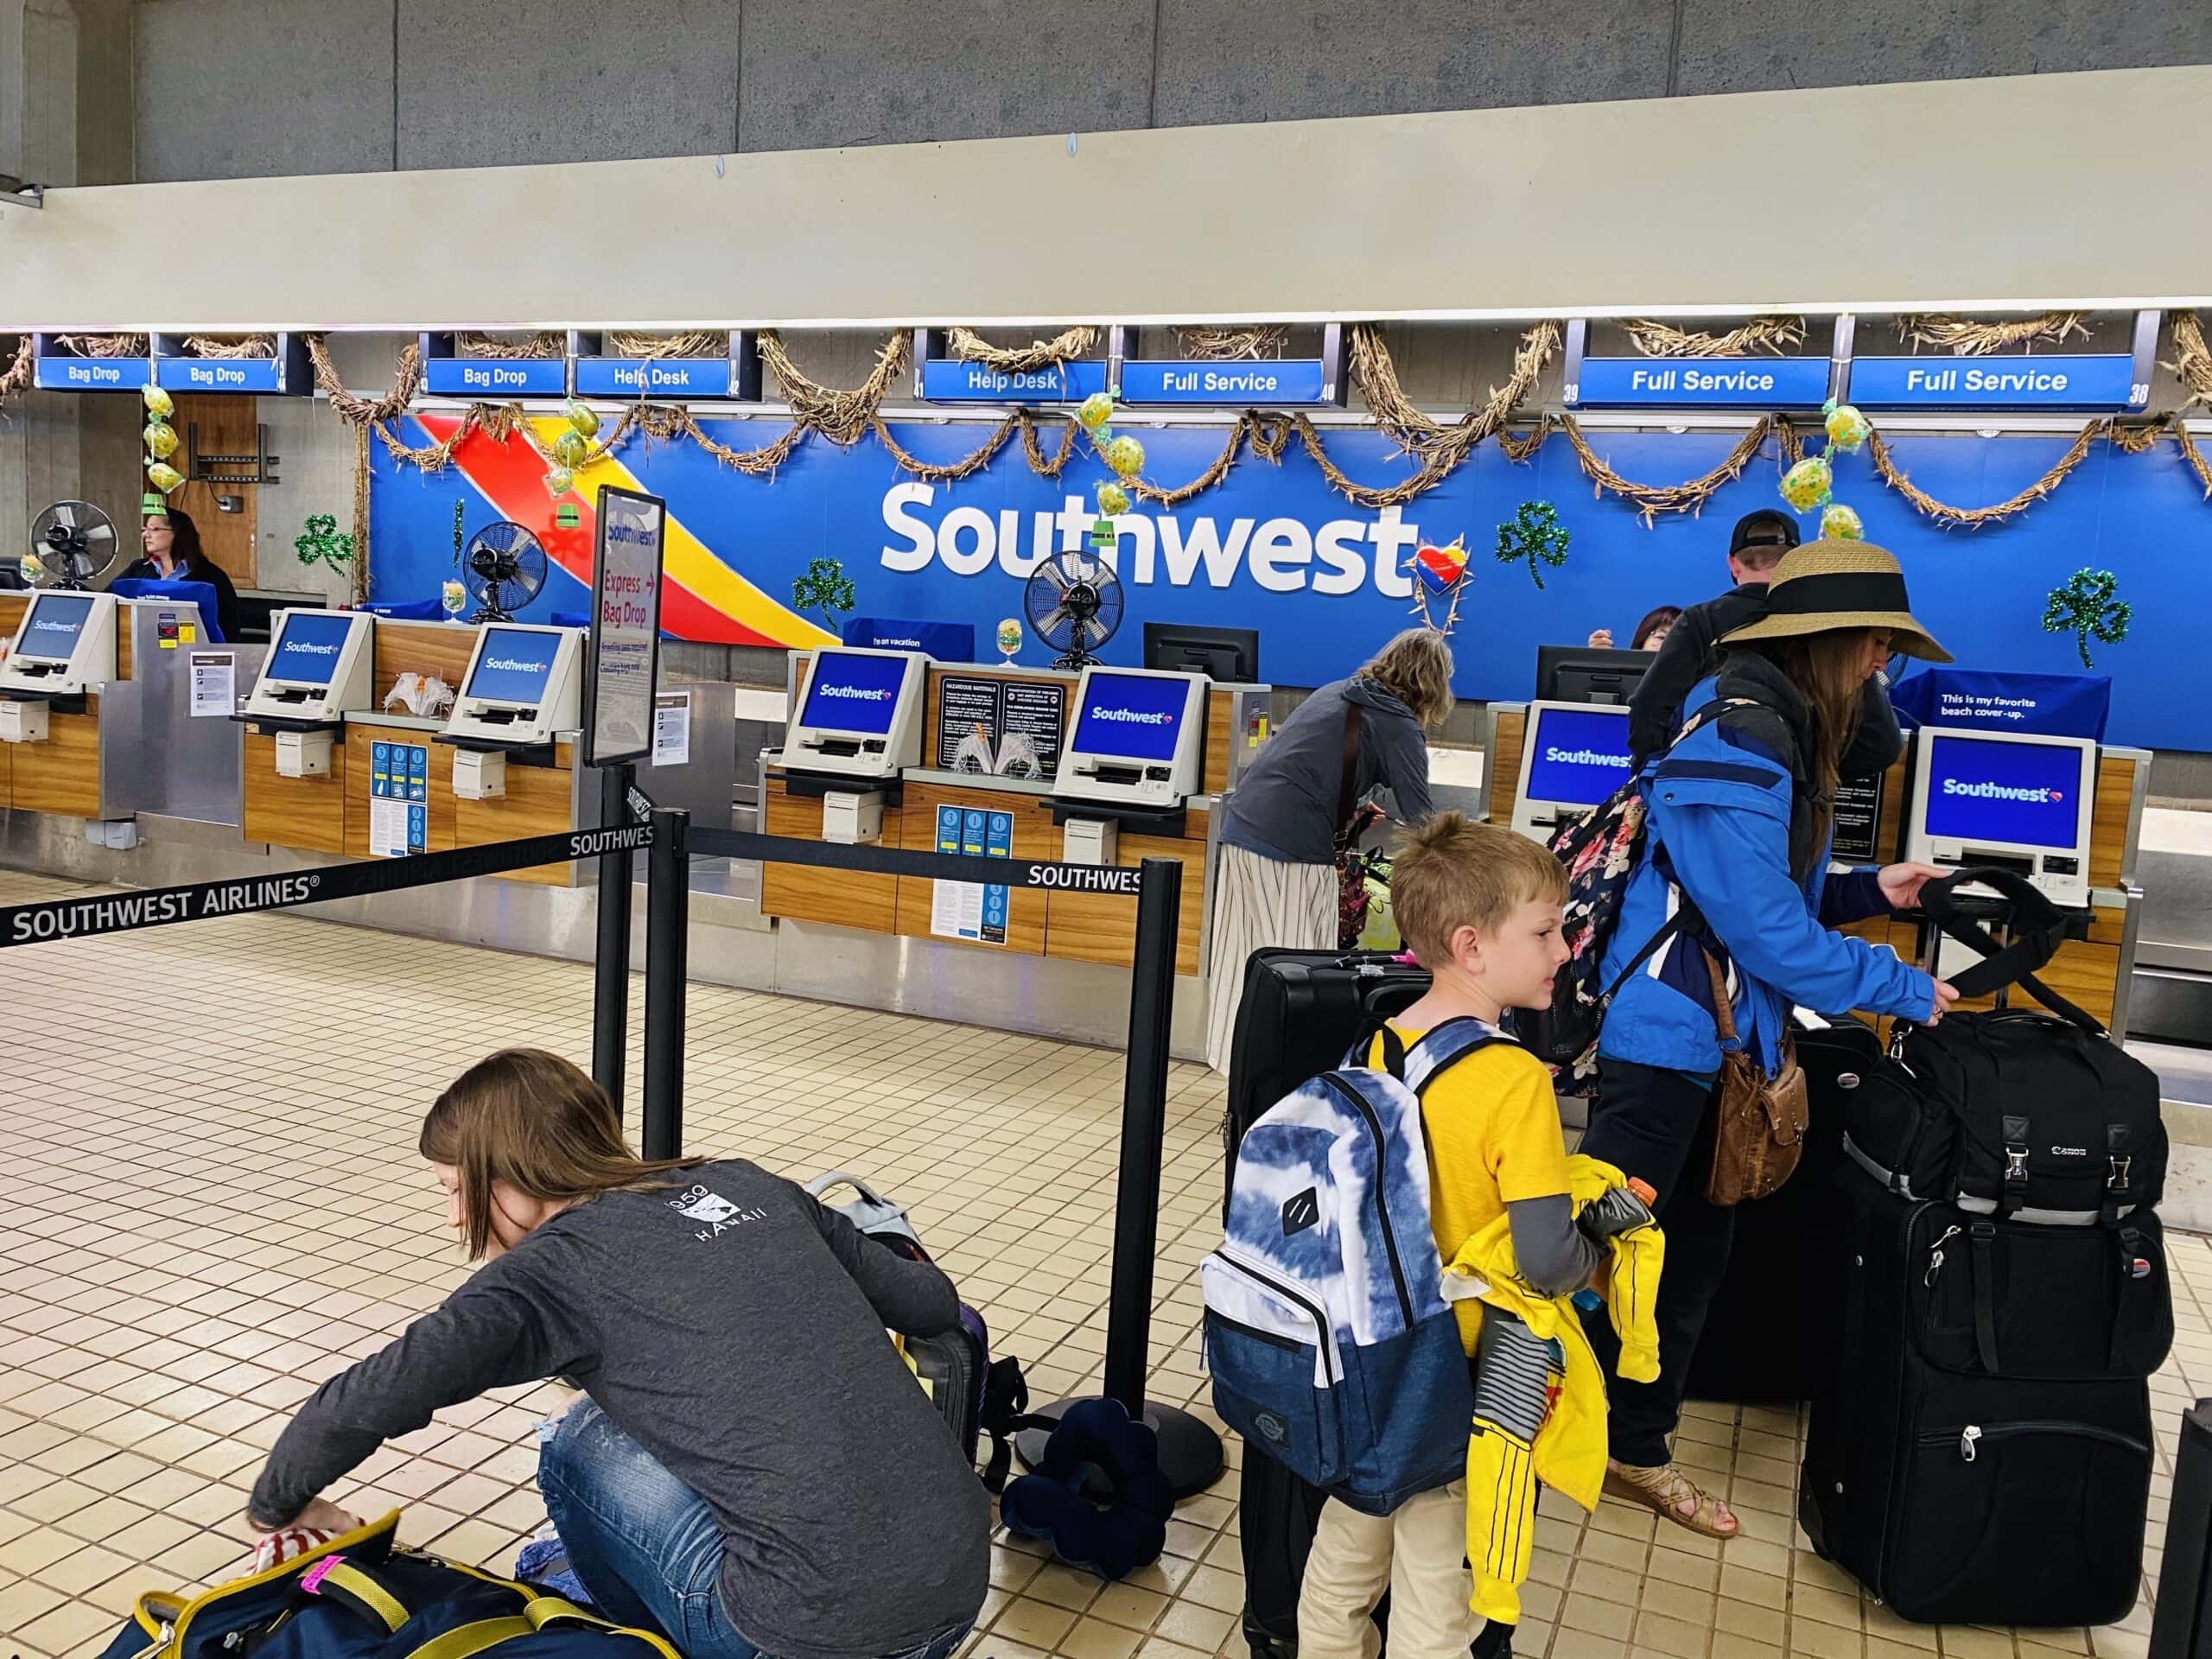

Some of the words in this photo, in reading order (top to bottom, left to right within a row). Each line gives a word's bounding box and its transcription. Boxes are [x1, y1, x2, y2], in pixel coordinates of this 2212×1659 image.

[68, 366, 91, 383] Bag
[92, 366, 120, 383] Drop
[189, 367, 213, 385] Bag
[216, 368, 245, 385] Drop
[463, 368, 490, 387] Bag
[493, 368, 527, 387] Drop
[613, 368, 647, 387] Help
[652, 369, 690, 385] Desk
[968, 372, 1007, 392] Help
[1013, 373, 1058, 390] Desk
[1163, 372, 1198, 391] Full
[1204, 372, 1278, 391] Service
[1631, 371, 1676, 391] Full
[1682, 370, 1775, 391] Service
[1906, 369, 1957, 391] Full
[1963, 369, 2069, 391] Service
[1322, 383, 1335, 402] 40
[1563, 384, 1579, 402] 39
[2129, 383, 2150, 404] 38
[607, 524, 652, 546] Southwest
[880, 482, 1420, 598] Southwest
[604, 569, 641, 598] Express
[603, 601, 621, 629] Bag
[624, 601, 646, 629] Drop
[34, 620, 76, 632] Southwest
[284, 640, 333, 655] Southwest
[890, 639, 920, 648] vacation
[485, 658, 540, 673] Southwest
[819, 683, 884, 701] Southwest
[1942, 694, 1963, 703] This
[1966, 695, 1974, 704] is
[1976, 697, 1993, 707] my
[1994, 696, 2036, 708] favorite
[1091, 706, 1163, 725] Southwest
[1941, 706, 1972, 715] beach
[1974, 709, 2025, 719] cover-up.
[1943, 778, 2049, 803] Southwest
[12, 892, 193, 941] SOUTHWEST
[2050, 1146, 2087, 1156] Canon
[694, 1207, 767, 1242] HAWAII
